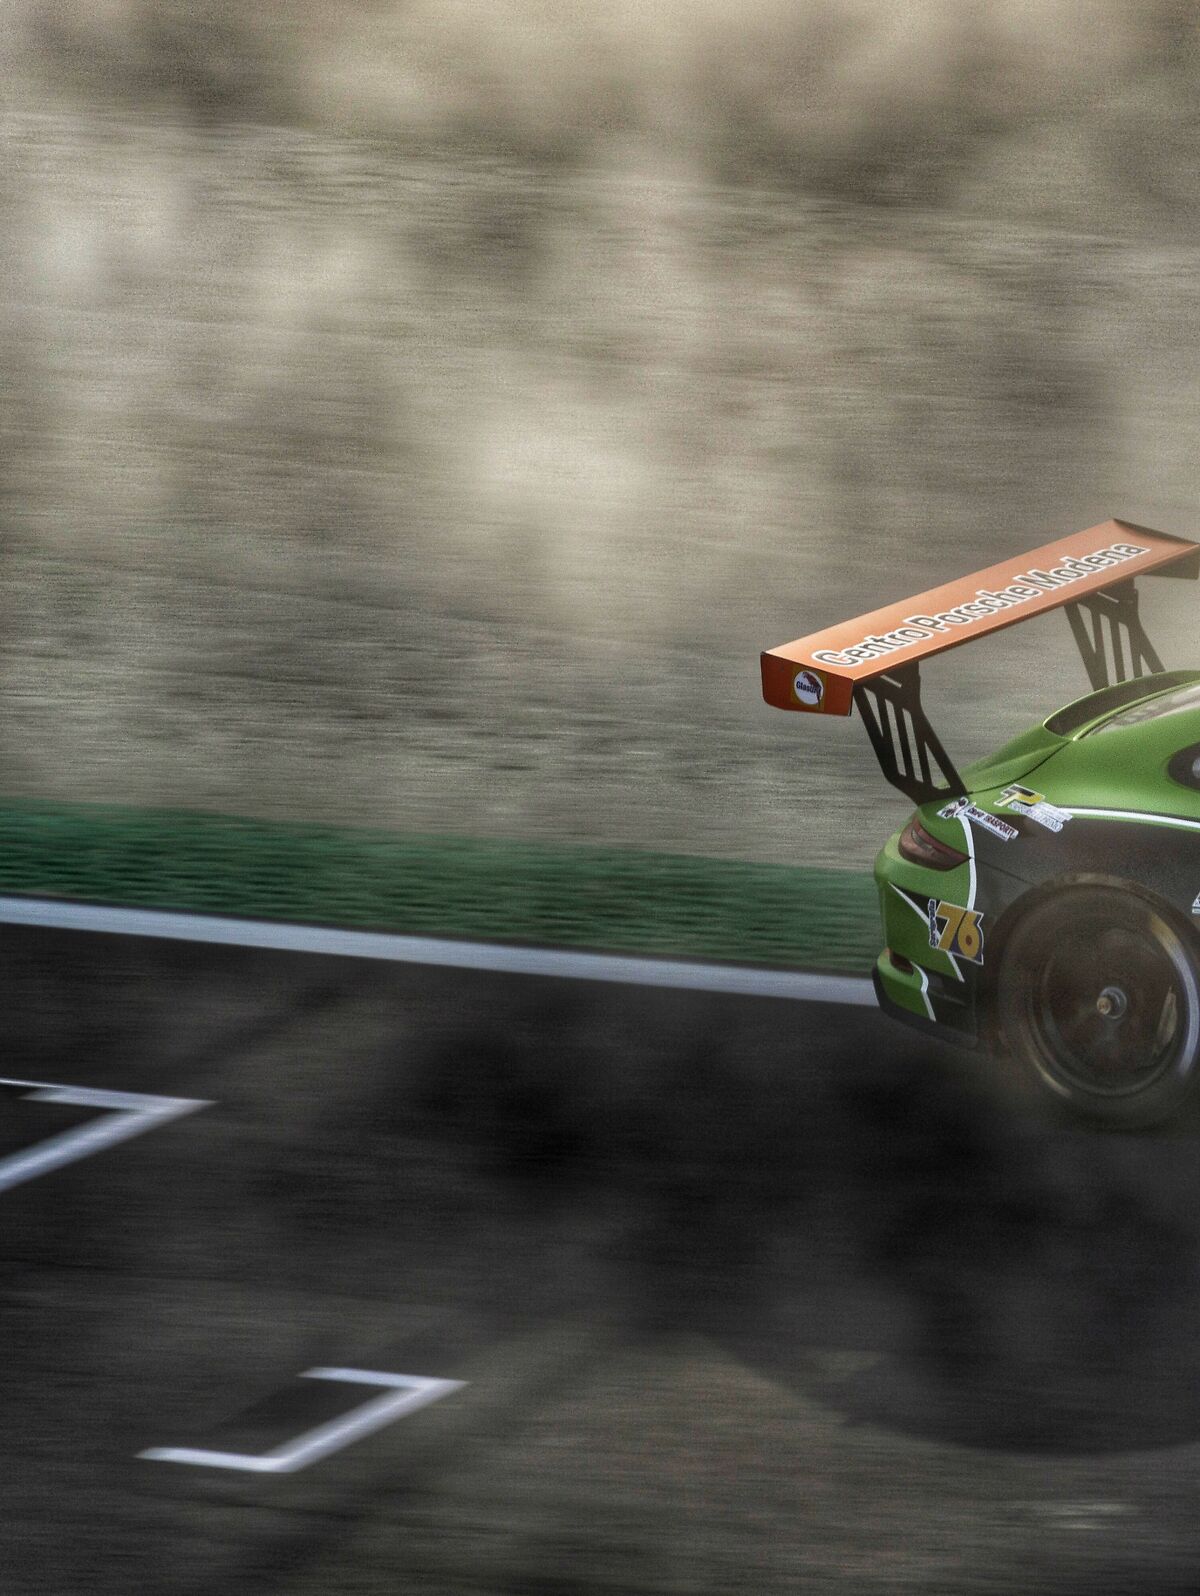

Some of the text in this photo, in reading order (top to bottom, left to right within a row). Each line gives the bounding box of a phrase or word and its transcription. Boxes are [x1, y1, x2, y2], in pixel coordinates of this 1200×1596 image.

[811, 543, 1152, 669] Centro Porsche Modena
